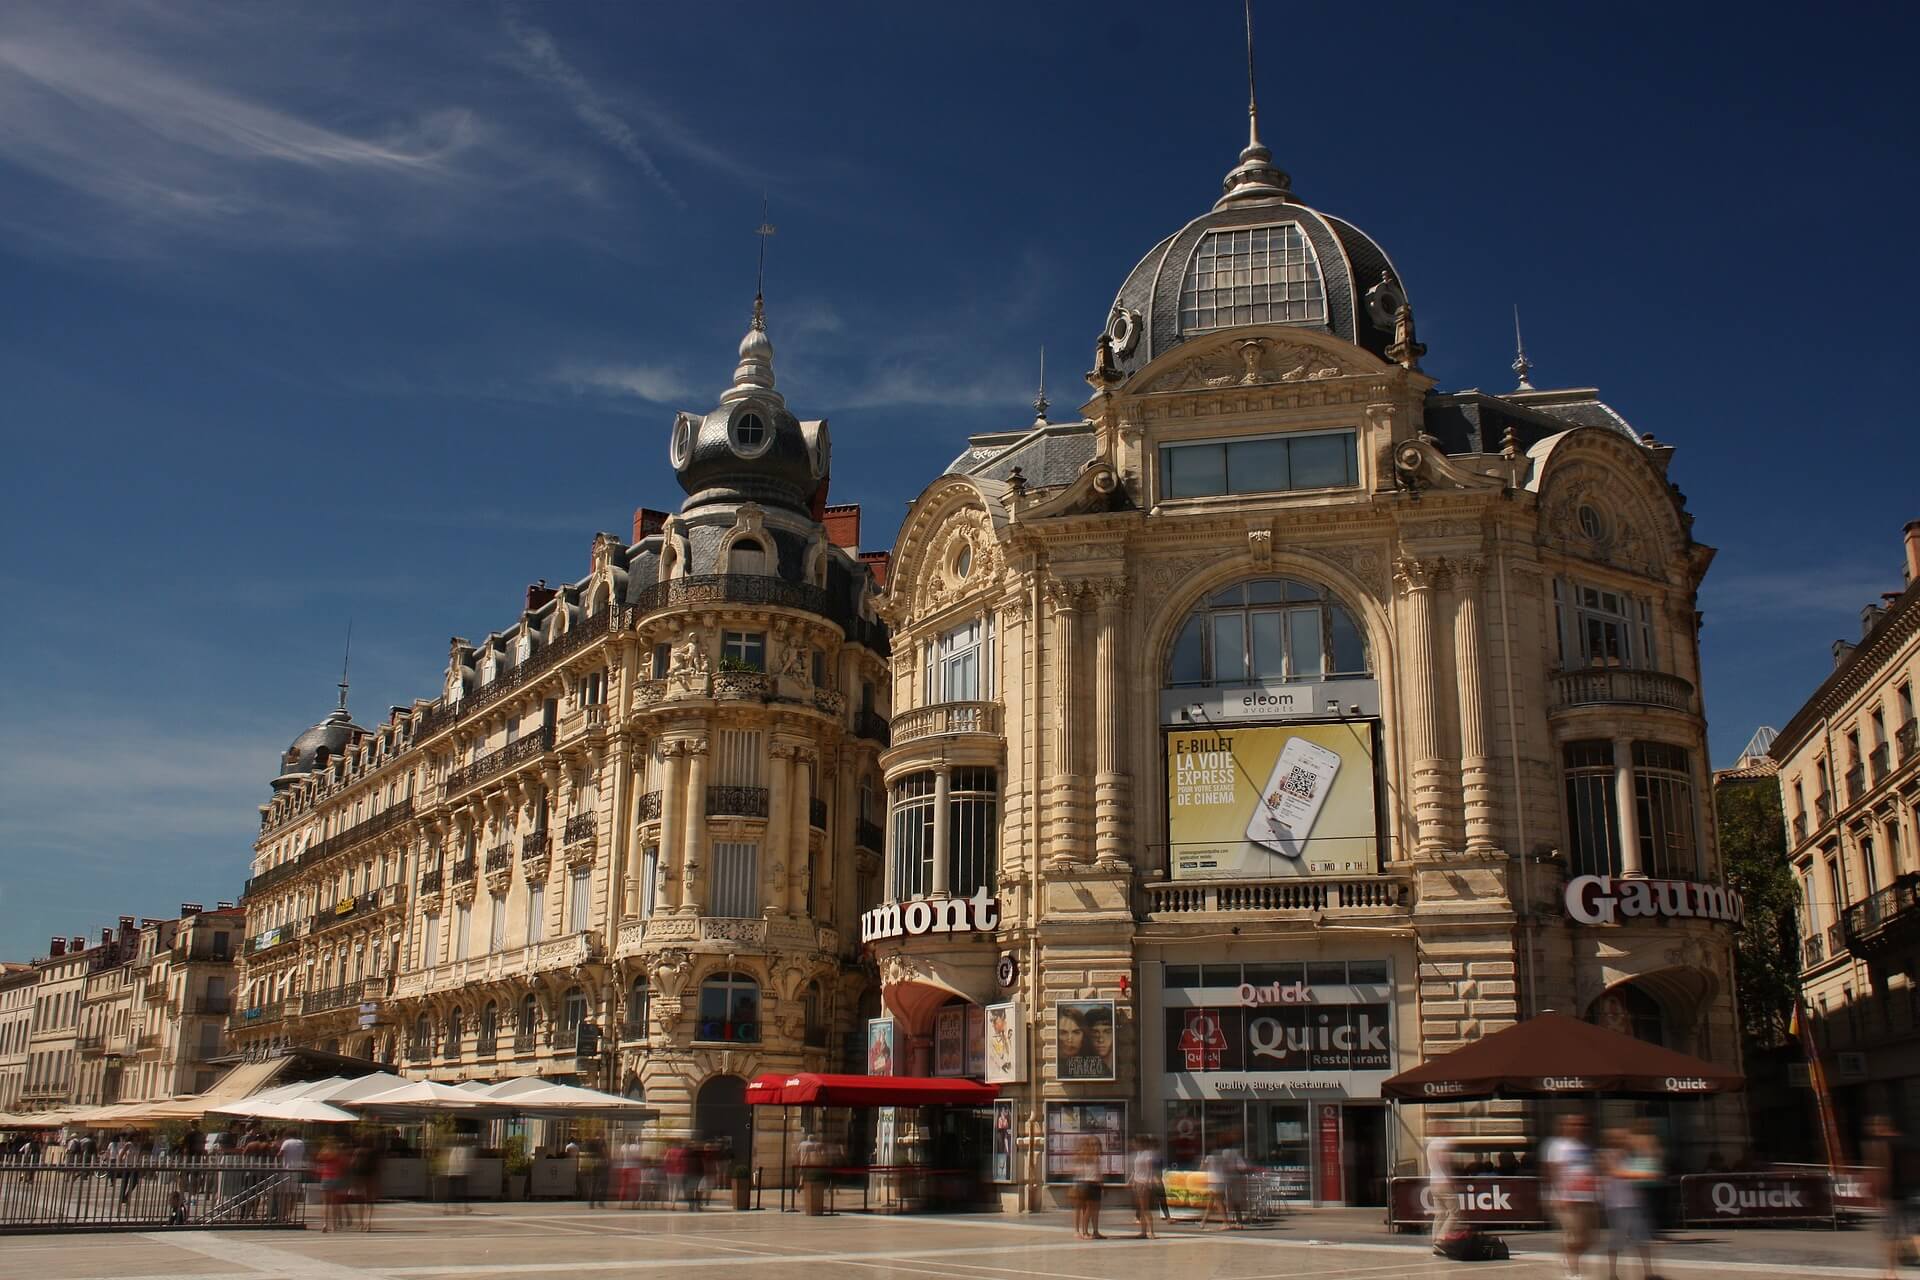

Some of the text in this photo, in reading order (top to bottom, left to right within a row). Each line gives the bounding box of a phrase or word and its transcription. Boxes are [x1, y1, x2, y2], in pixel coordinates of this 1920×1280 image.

[1243, 691, 1293, 706] eleom
[1243, 705, 1294, 714] avocats
[1176, 737, 1234, 754] E-BILLET
[1177, 752, 1234, 770] LA VOIE
[1177, 769, 1234, 786] EXPRESS
[1177, 793, 1192, 805] DE
[1238, 981, 1312, 1007] Quick
[1250, 1014, 1386, 1059] Quick
[1312, 1054, 1390, 1065] Restaurant
[1213, 1079, 1342, 1092] Quality Burger Restaurant
[1423, 1079, 1464, 1097] Quick
[1542, 1074, 1586, 1092] Quick
[1664, 1075, 1709, 1092] Quick
[1711, 1182, 1804, 1216] Quick
